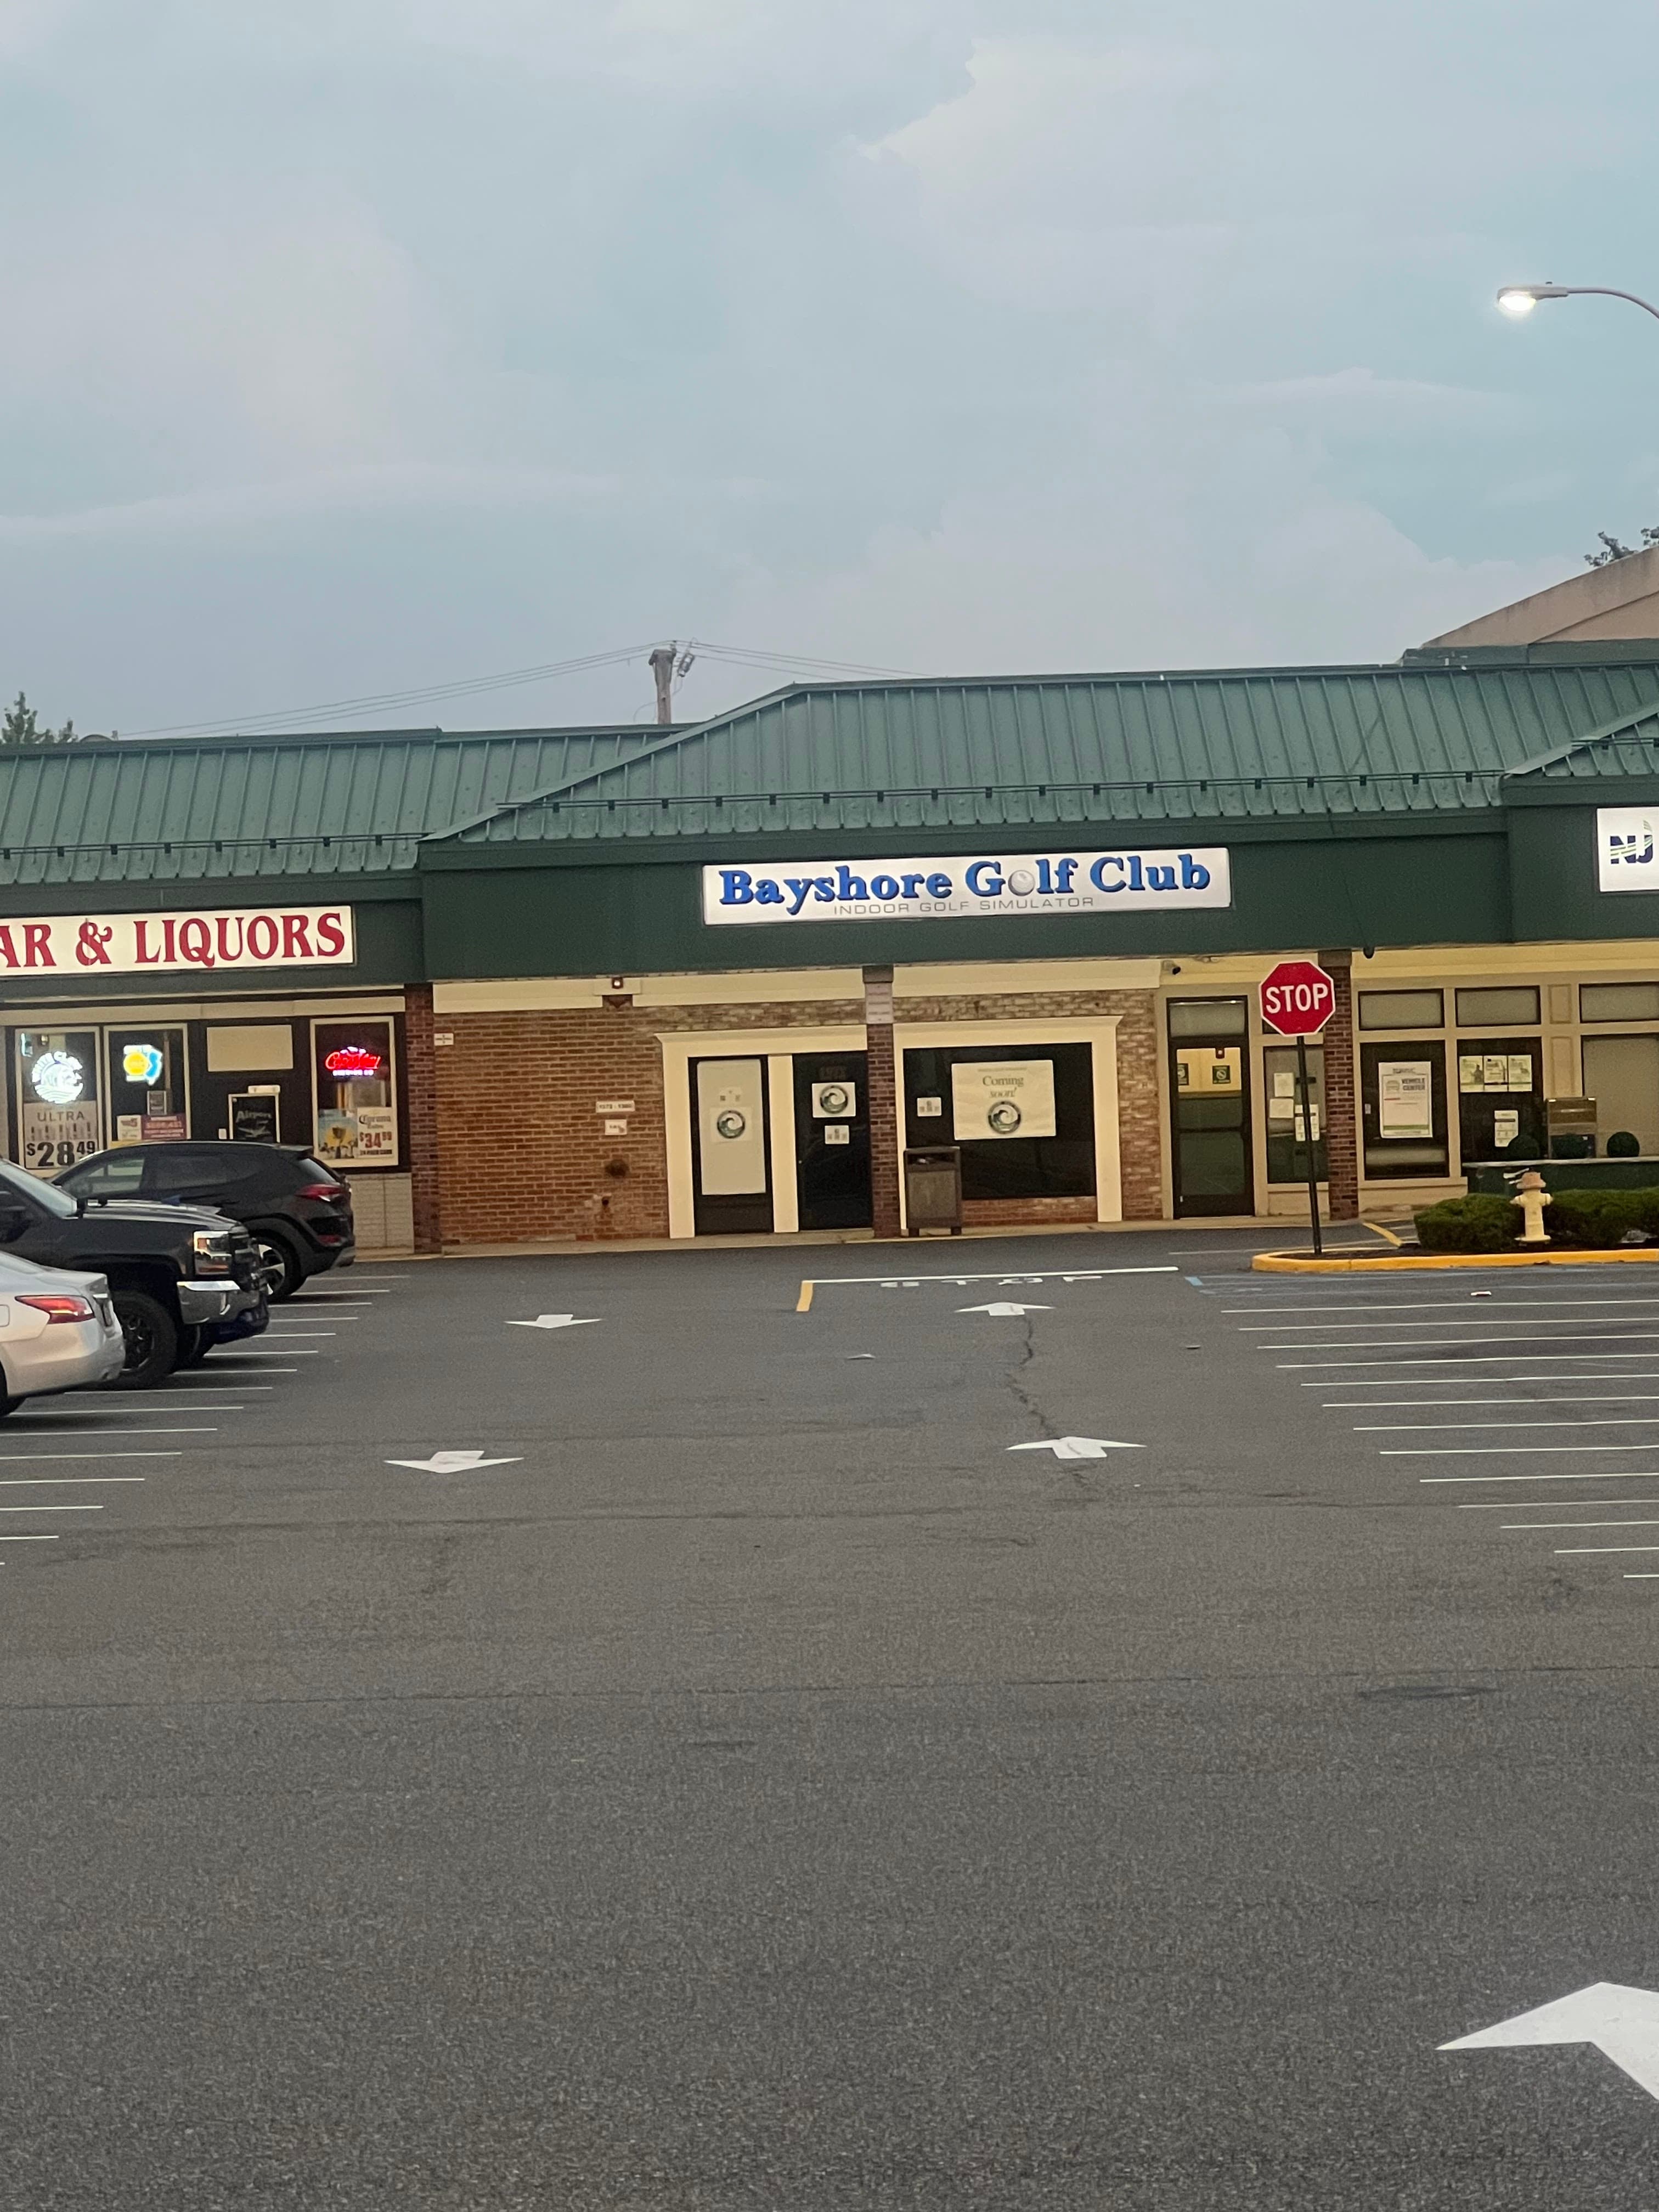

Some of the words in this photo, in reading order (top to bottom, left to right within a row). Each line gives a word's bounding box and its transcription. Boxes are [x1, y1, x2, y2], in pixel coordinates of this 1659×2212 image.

[719, 865, 952, 915] Bayshore
[965, 857, 1079, 897] Golf
[1090, 854, 1210, 893] Club
[834, 904, 909, 915] INDOOR
[919, 901, 969, 912] GOLF
[980, 897, 1094, 910] SIMULATOR
[76, 922, 112, 966] &
[133, 913, 345, 968] LIQUORS
[1266, 983, 1328, 1014] STOP
[983, 1075, 1024, 1087] Coming
[37, 1111, 84, 1122] ULTRA
